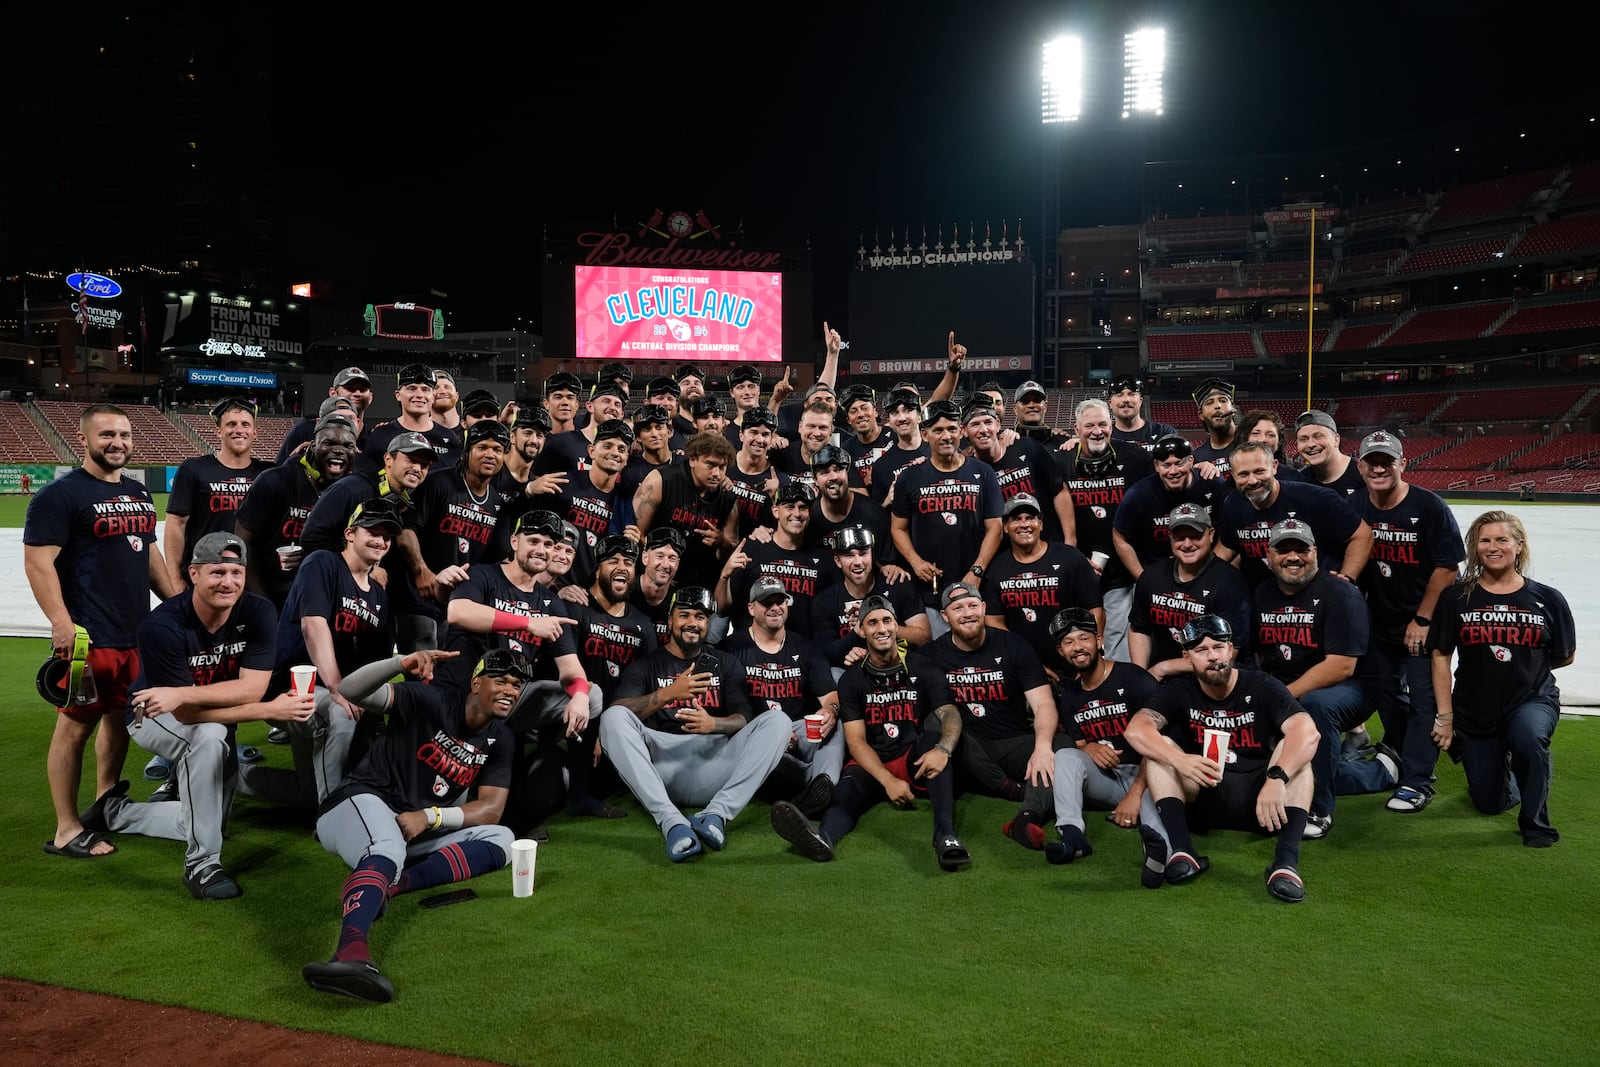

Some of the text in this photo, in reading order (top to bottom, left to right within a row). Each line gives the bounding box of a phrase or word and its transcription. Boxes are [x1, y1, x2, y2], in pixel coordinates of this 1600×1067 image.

[576, 232, 781, 269] Budweiser
[869, 250, 1013, 268] WORLD CHAMPIONS
[78, 276, 112, 294] Ford
[652, 275, 710, 284] CONGRATULATIONS
[222, 298, 252, 308] PHORM
[606, 284, 755, 329] CLEVELAND
[70, 302, 122, 320] Cmunity
[210, 304, 280, 327] FROM THE
[210, 318, 270, 338] LOU AND
[258, 337, 302, 354] PROUD
[621, 341, 740, 352] AL CENTRAL DIVISION CHAMPIONS
[878, 358, 999, 372] BROWN & CRUPPEN
[190, 372, 274, 386] SCOTT CREDIT UNION
[997, 466, 1030, 486] WN THE
[1068, 476, 1125, 489] WE OWN THE
[208, 482, 229, 492] WE
[920, 484, 980, 495] WE OWN THE
[750, 492, 766, 504] THE
[918, 495, 977, 514] CENTRAL
[92, 502, 115, 514] WE
[114, 502, 142, 512] OWN
[288, 506, 308, 519] WE
[572, 496, 588, 509] WE
[588, 504, 609, 518] OWN
[448, 504, 498, 526] WE OWN THE
[1152, 517, 1170, 526] WE
[93, 515, 156, 539] CENTRA
[440, 516, 493, 545] CENTRAL
[1236, 529, 1250, 539] WE
[1372, 530, 1418, 542] OWN THE
[1370, 543, 1420, 564] NTRAL
[760, 564, 818, 578] WE OWN THE
[1000, 576, 1059, 590] WE OWN THE
[342, 596, 357, 610] WE
[494, 598, 512, 613] WE
[1001, 590, 1062, 608] CENTRAL
[1152, 594, 1206, 614] WE OWN THE
[1260, 612, 1314, 624] WE OWN THE
[1460, 612, 1544, 626] WE OWN THE
[590, 623, 642, 646] WE OWN THE
[1259, 626, 1319, 648] CENTRAL
[1459, 626, 1542, 648] CENTRAL
[188, 654, 206, 667] WE
[746, 666, 802, 680] WE OWN THE
[956, 673, 982, 684] OWN
[982, 670, 1004, 682] THE
[877, 690, 900, 704] OWN
[950, 684, 1008, 702] NTRAL
[1083, 706, 1106, 720] OWN
[1106, 702, 1128, 715] THE
[1205, 716, 1236, 728] OWN
[1236, 712, 1255, 726] THE
[434, 730, 454, 749] WE
[450, 745, 475, 765] OWN
